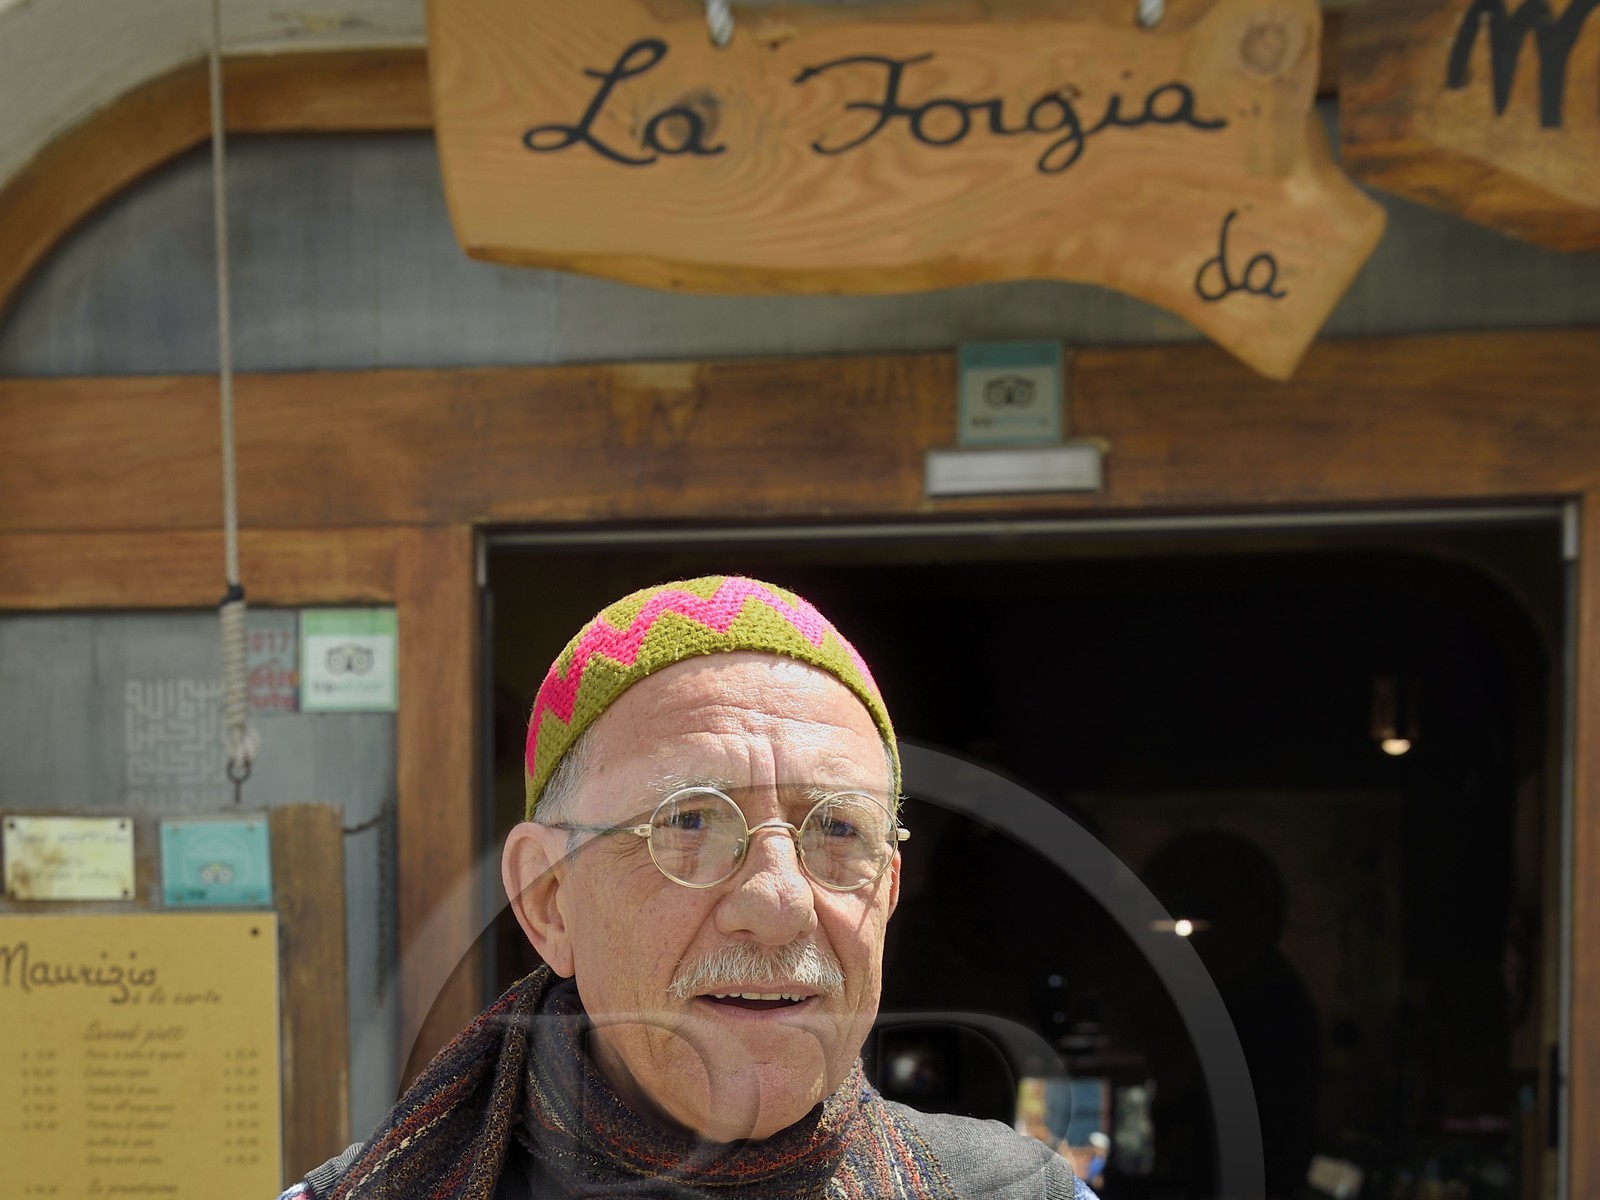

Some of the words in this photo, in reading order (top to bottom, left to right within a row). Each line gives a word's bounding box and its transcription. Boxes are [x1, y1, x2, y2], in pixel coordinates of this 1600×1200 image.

[522, 38, 727, 167] La
[792, 51, 1229, 175] Forgia
[1195, 209, 1287, 302] da
